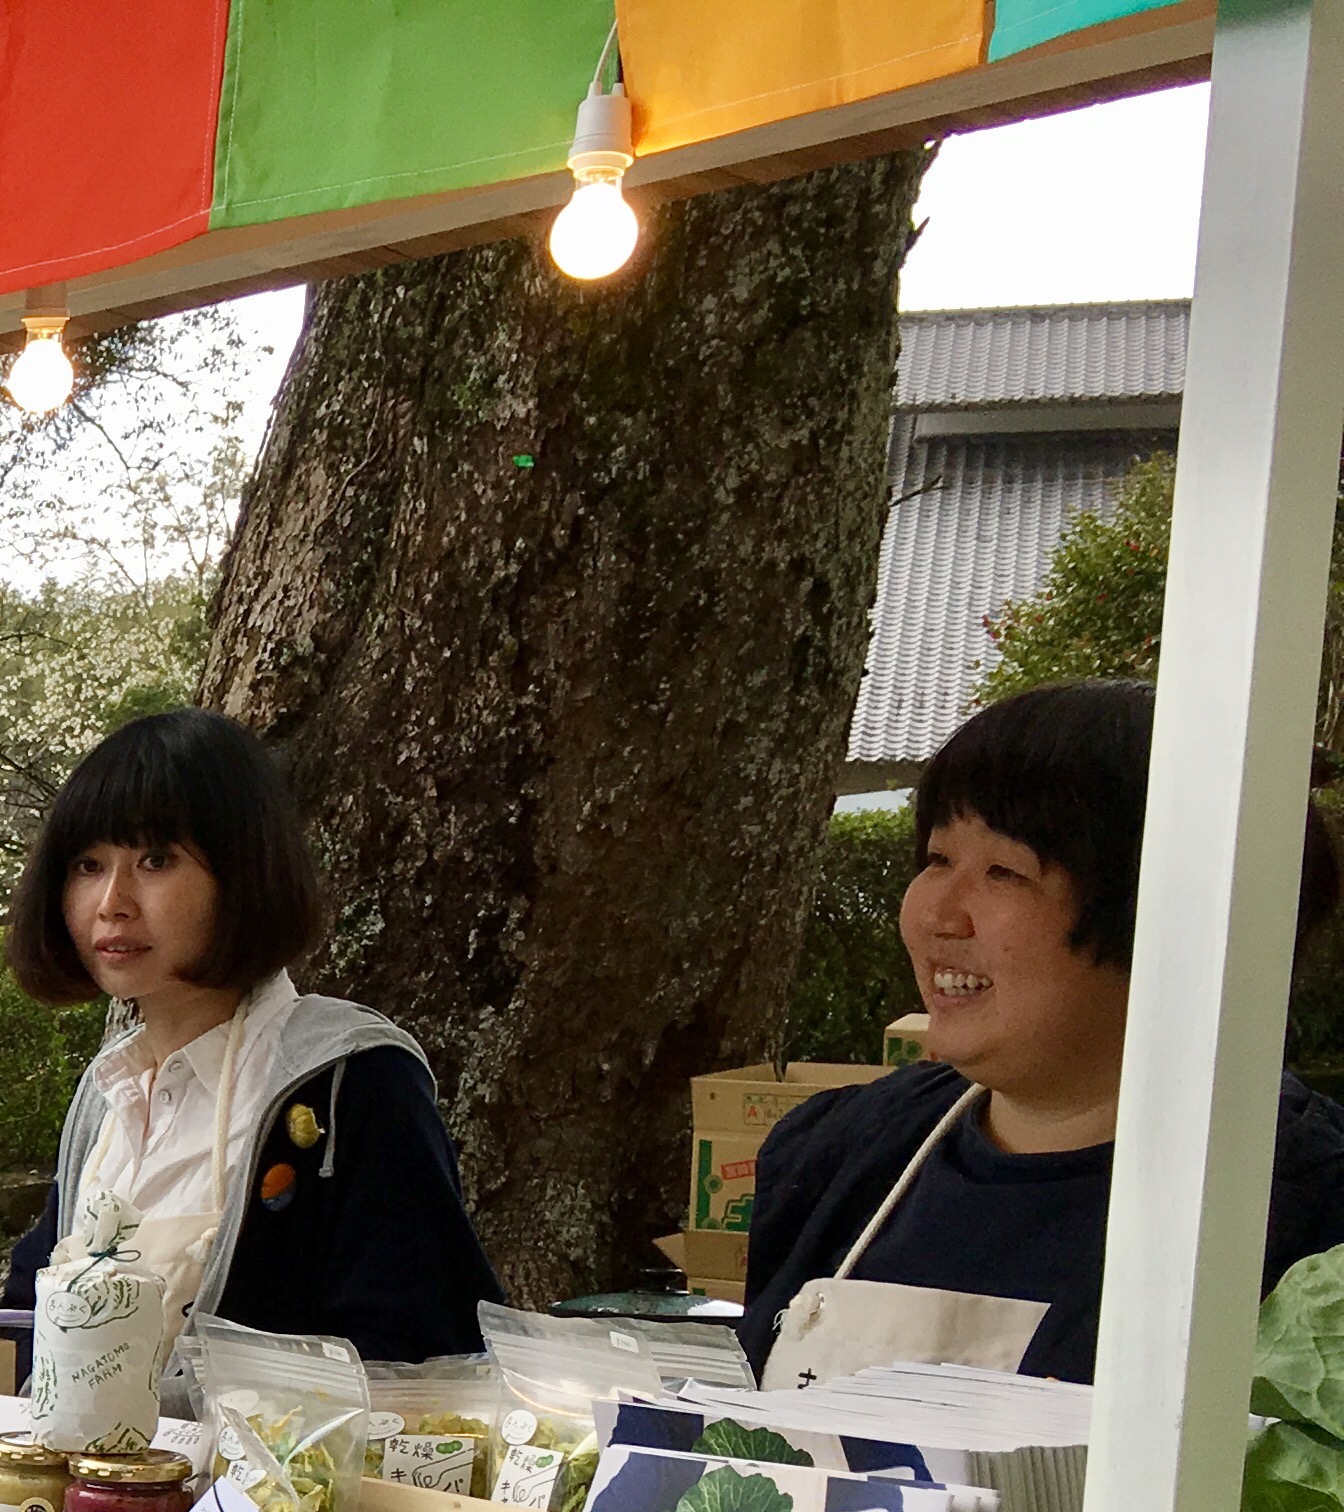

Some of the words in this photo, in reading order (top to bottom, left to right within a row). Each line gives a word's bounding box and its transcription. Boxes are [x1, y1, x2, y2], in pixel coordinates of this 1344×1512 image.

[70, 1341, 131, 1384] NAGATOMO
[87, 1362, 123, 1391] FARM
[388, 1437, 434, 1461] 乾燥
[508, 1445, 534, 1475] 乾燥
